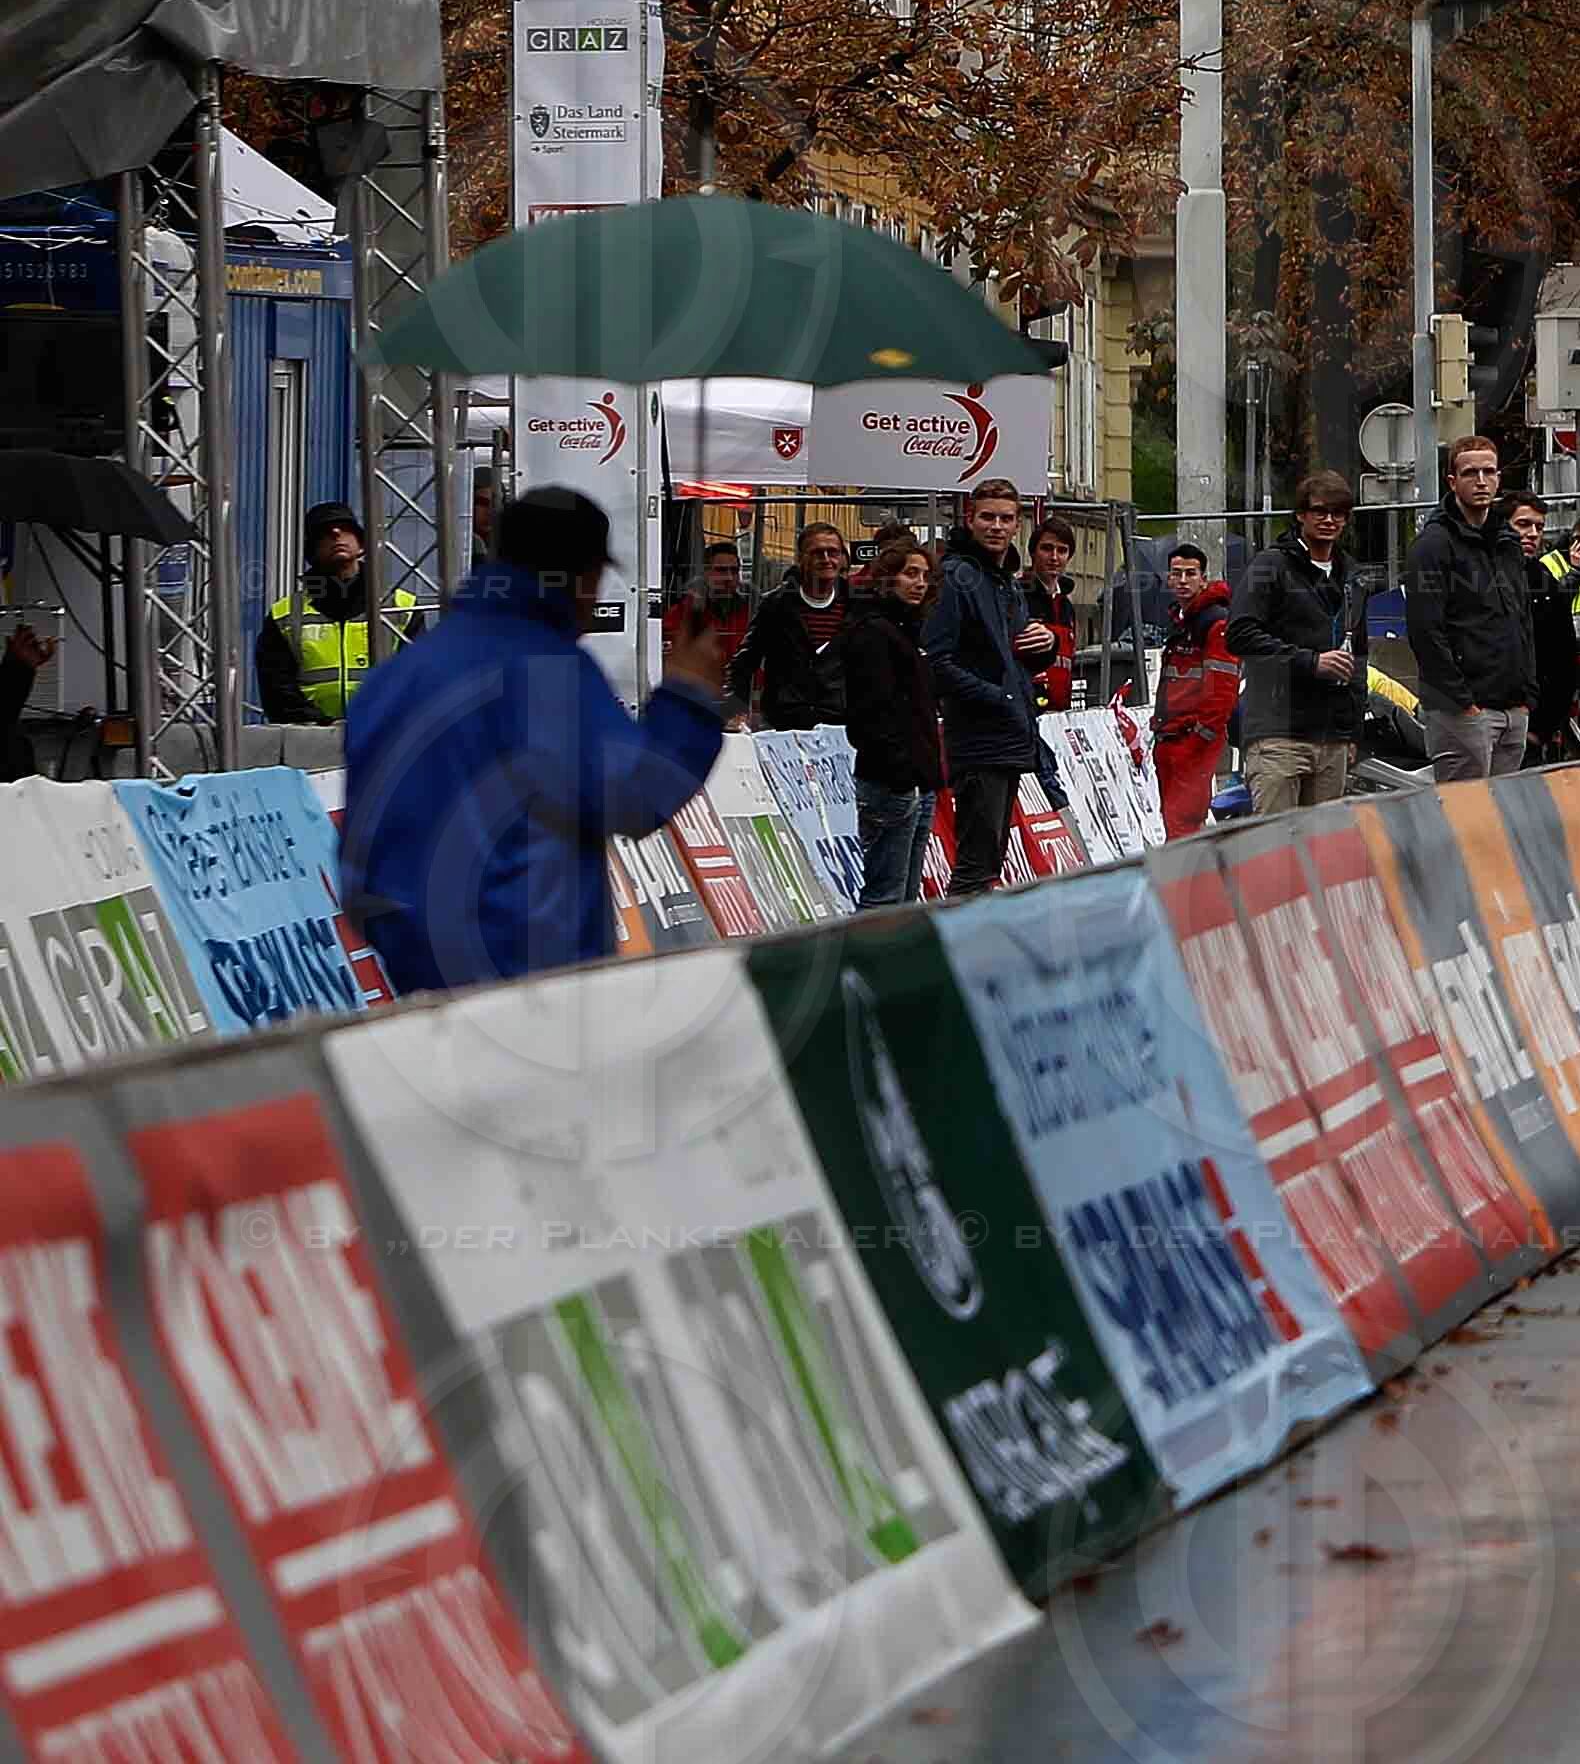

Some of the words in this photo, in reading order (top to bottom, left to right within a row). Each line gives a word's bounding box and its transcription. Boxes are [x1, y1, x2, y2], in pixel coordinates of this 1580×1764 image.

[528, 29, 625, 50] GRAZ
[557, 105, 583, 119] Das
[588, 105, 623, 119] Land
[552, 126, 624, 140] Steiermark
[528, 419, 555, 433] Get
[558, 418, 605, 433] active
[862, 412, 901, 433] Get
[905, 413, 971, 435] active
